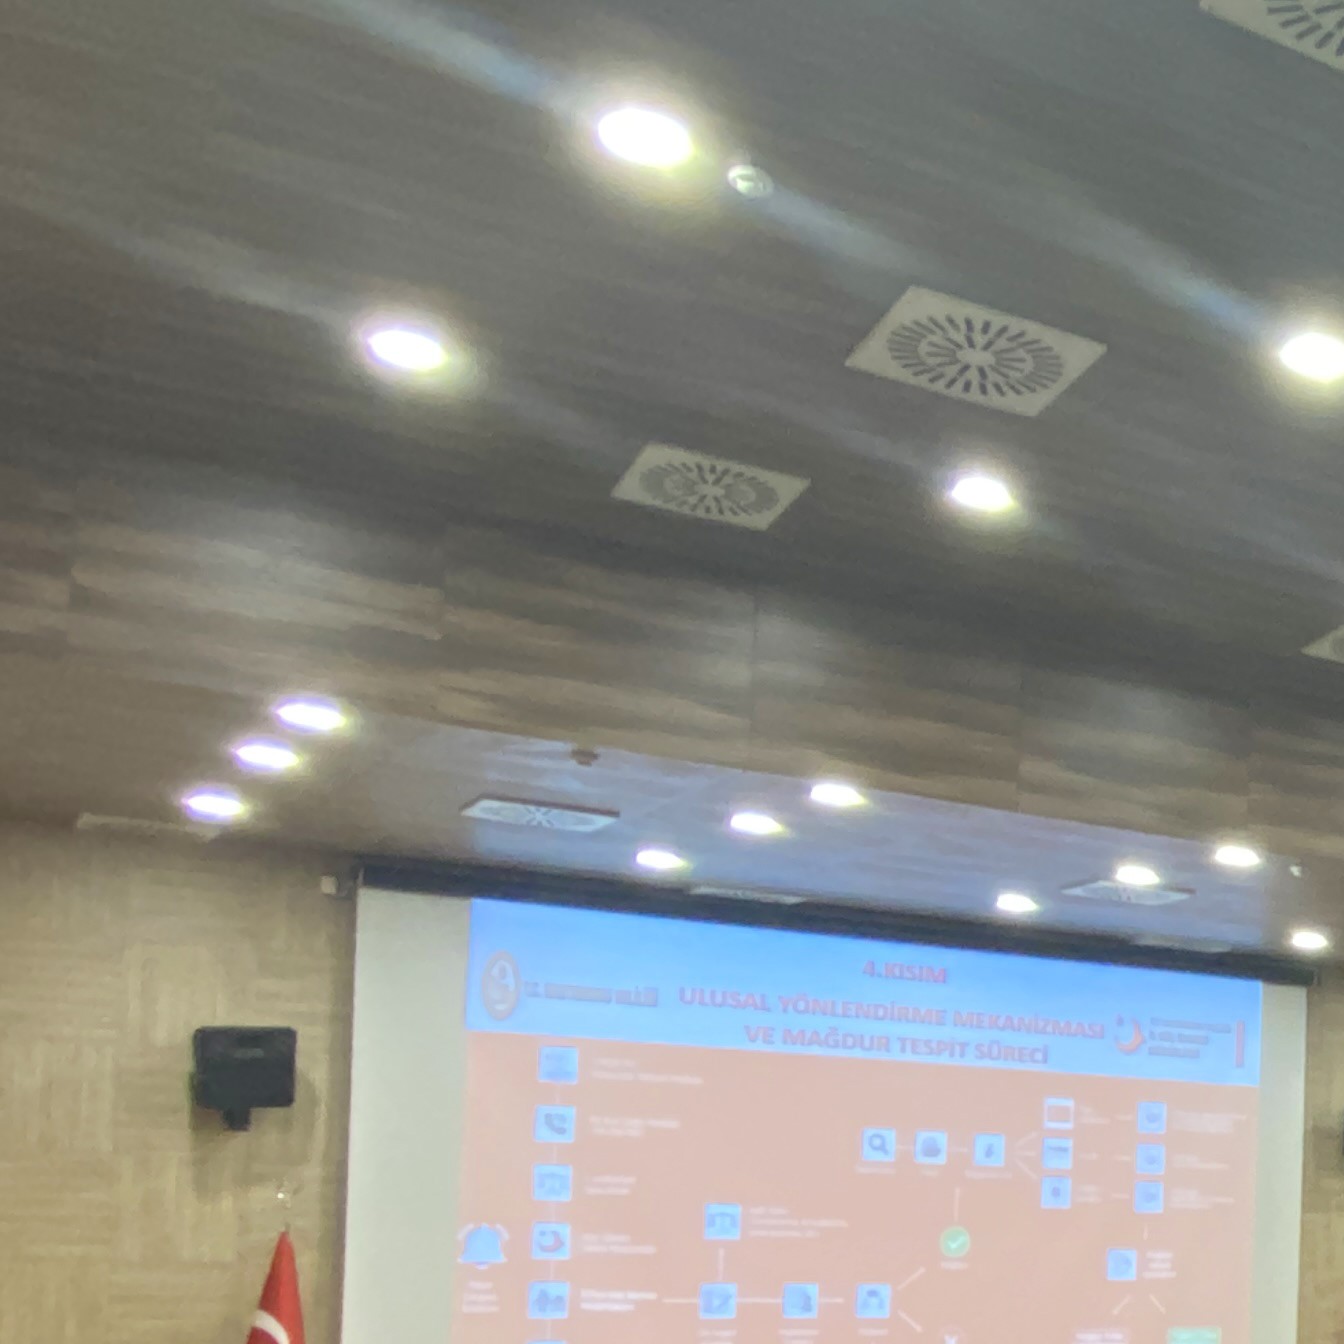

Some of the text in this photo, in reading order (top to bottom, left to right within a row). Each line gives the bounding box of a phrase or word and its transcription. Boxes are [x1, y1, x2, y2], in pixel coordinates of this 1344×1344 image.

[679, 987, 771, 1012] ULUSAL
[779, 993, 946, 1026] YÖNLENDİRME
[953, 1010, 1104, 1039] MEKANİZMASI
[745, 1025, 1049, 1064] VE MAĞDUR TESPİT SÜRECİ
